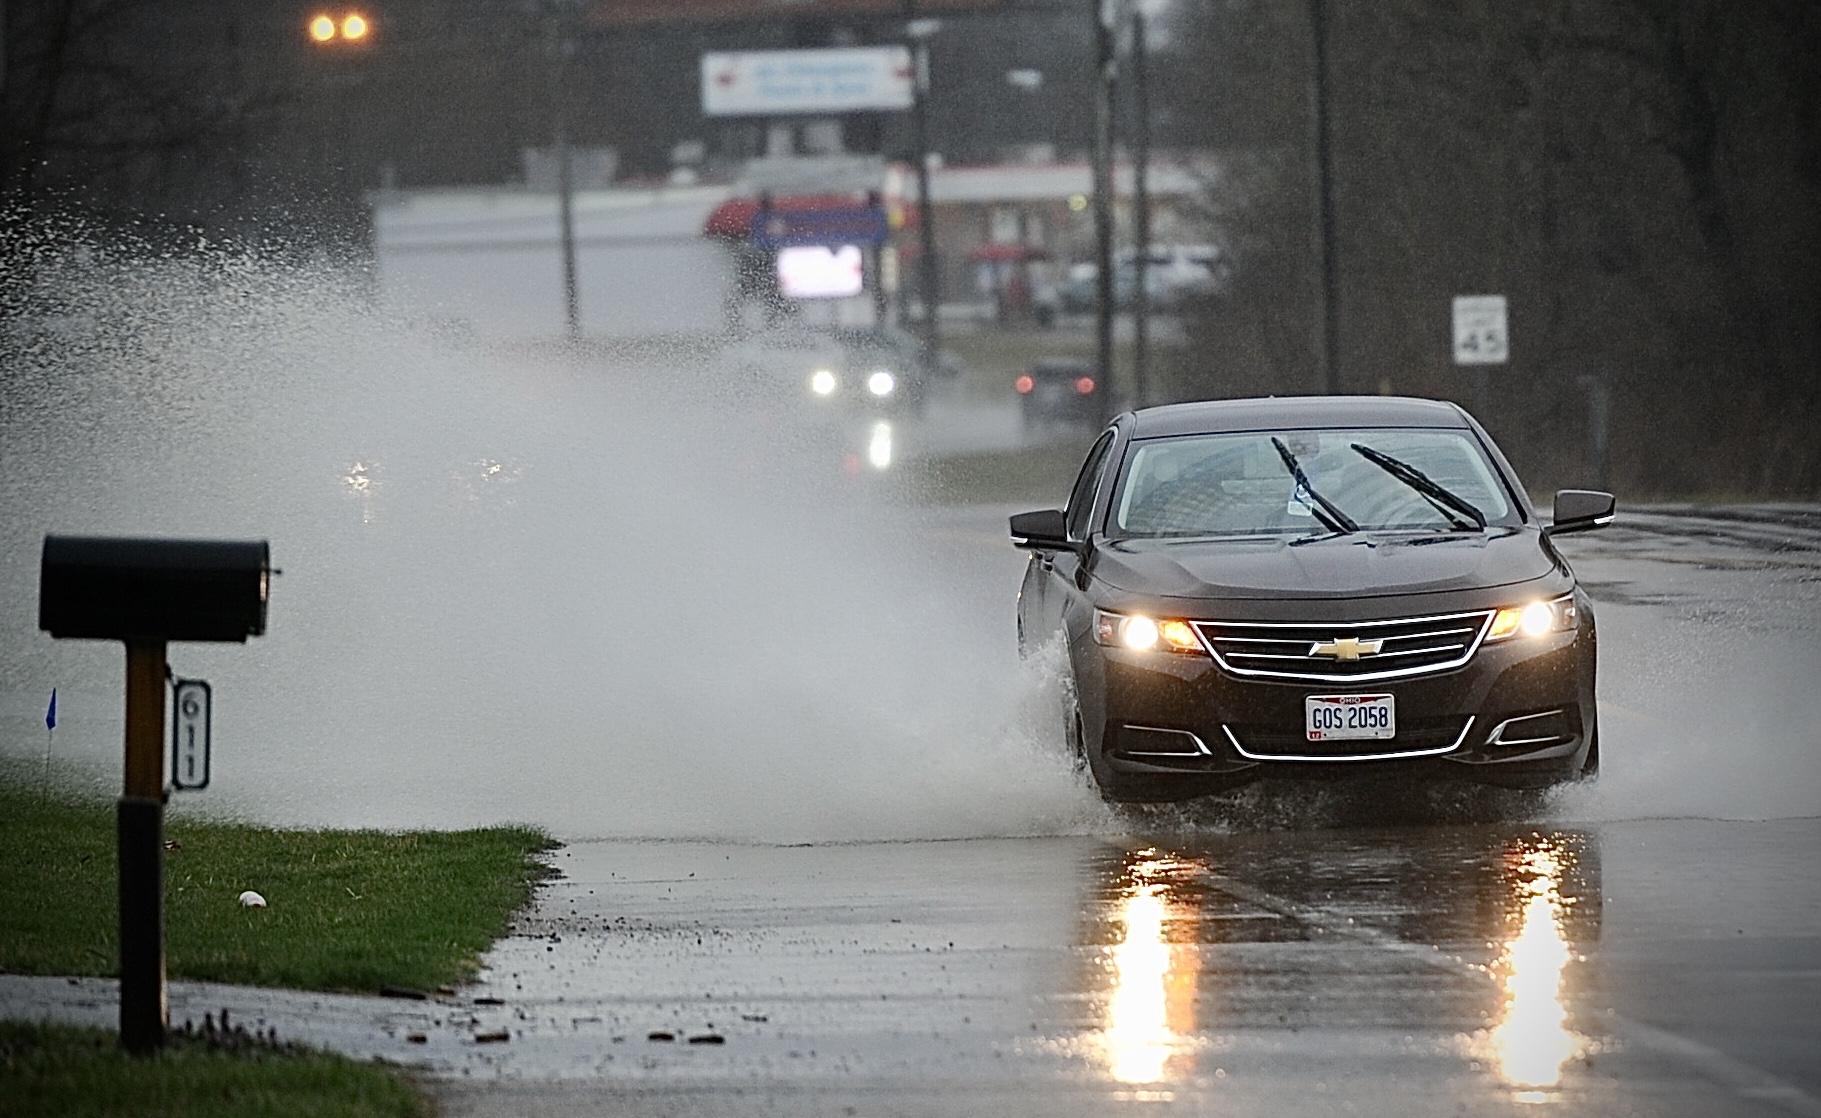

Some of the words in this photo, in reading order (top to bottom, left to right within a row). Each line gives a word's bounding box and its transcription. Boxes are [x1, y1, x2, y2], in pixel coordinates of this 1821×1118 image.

[1462, 330, 1501, 353] 45
[1348, 706, 1388, 728] 2058
[182, 691, 200, 780] 611
